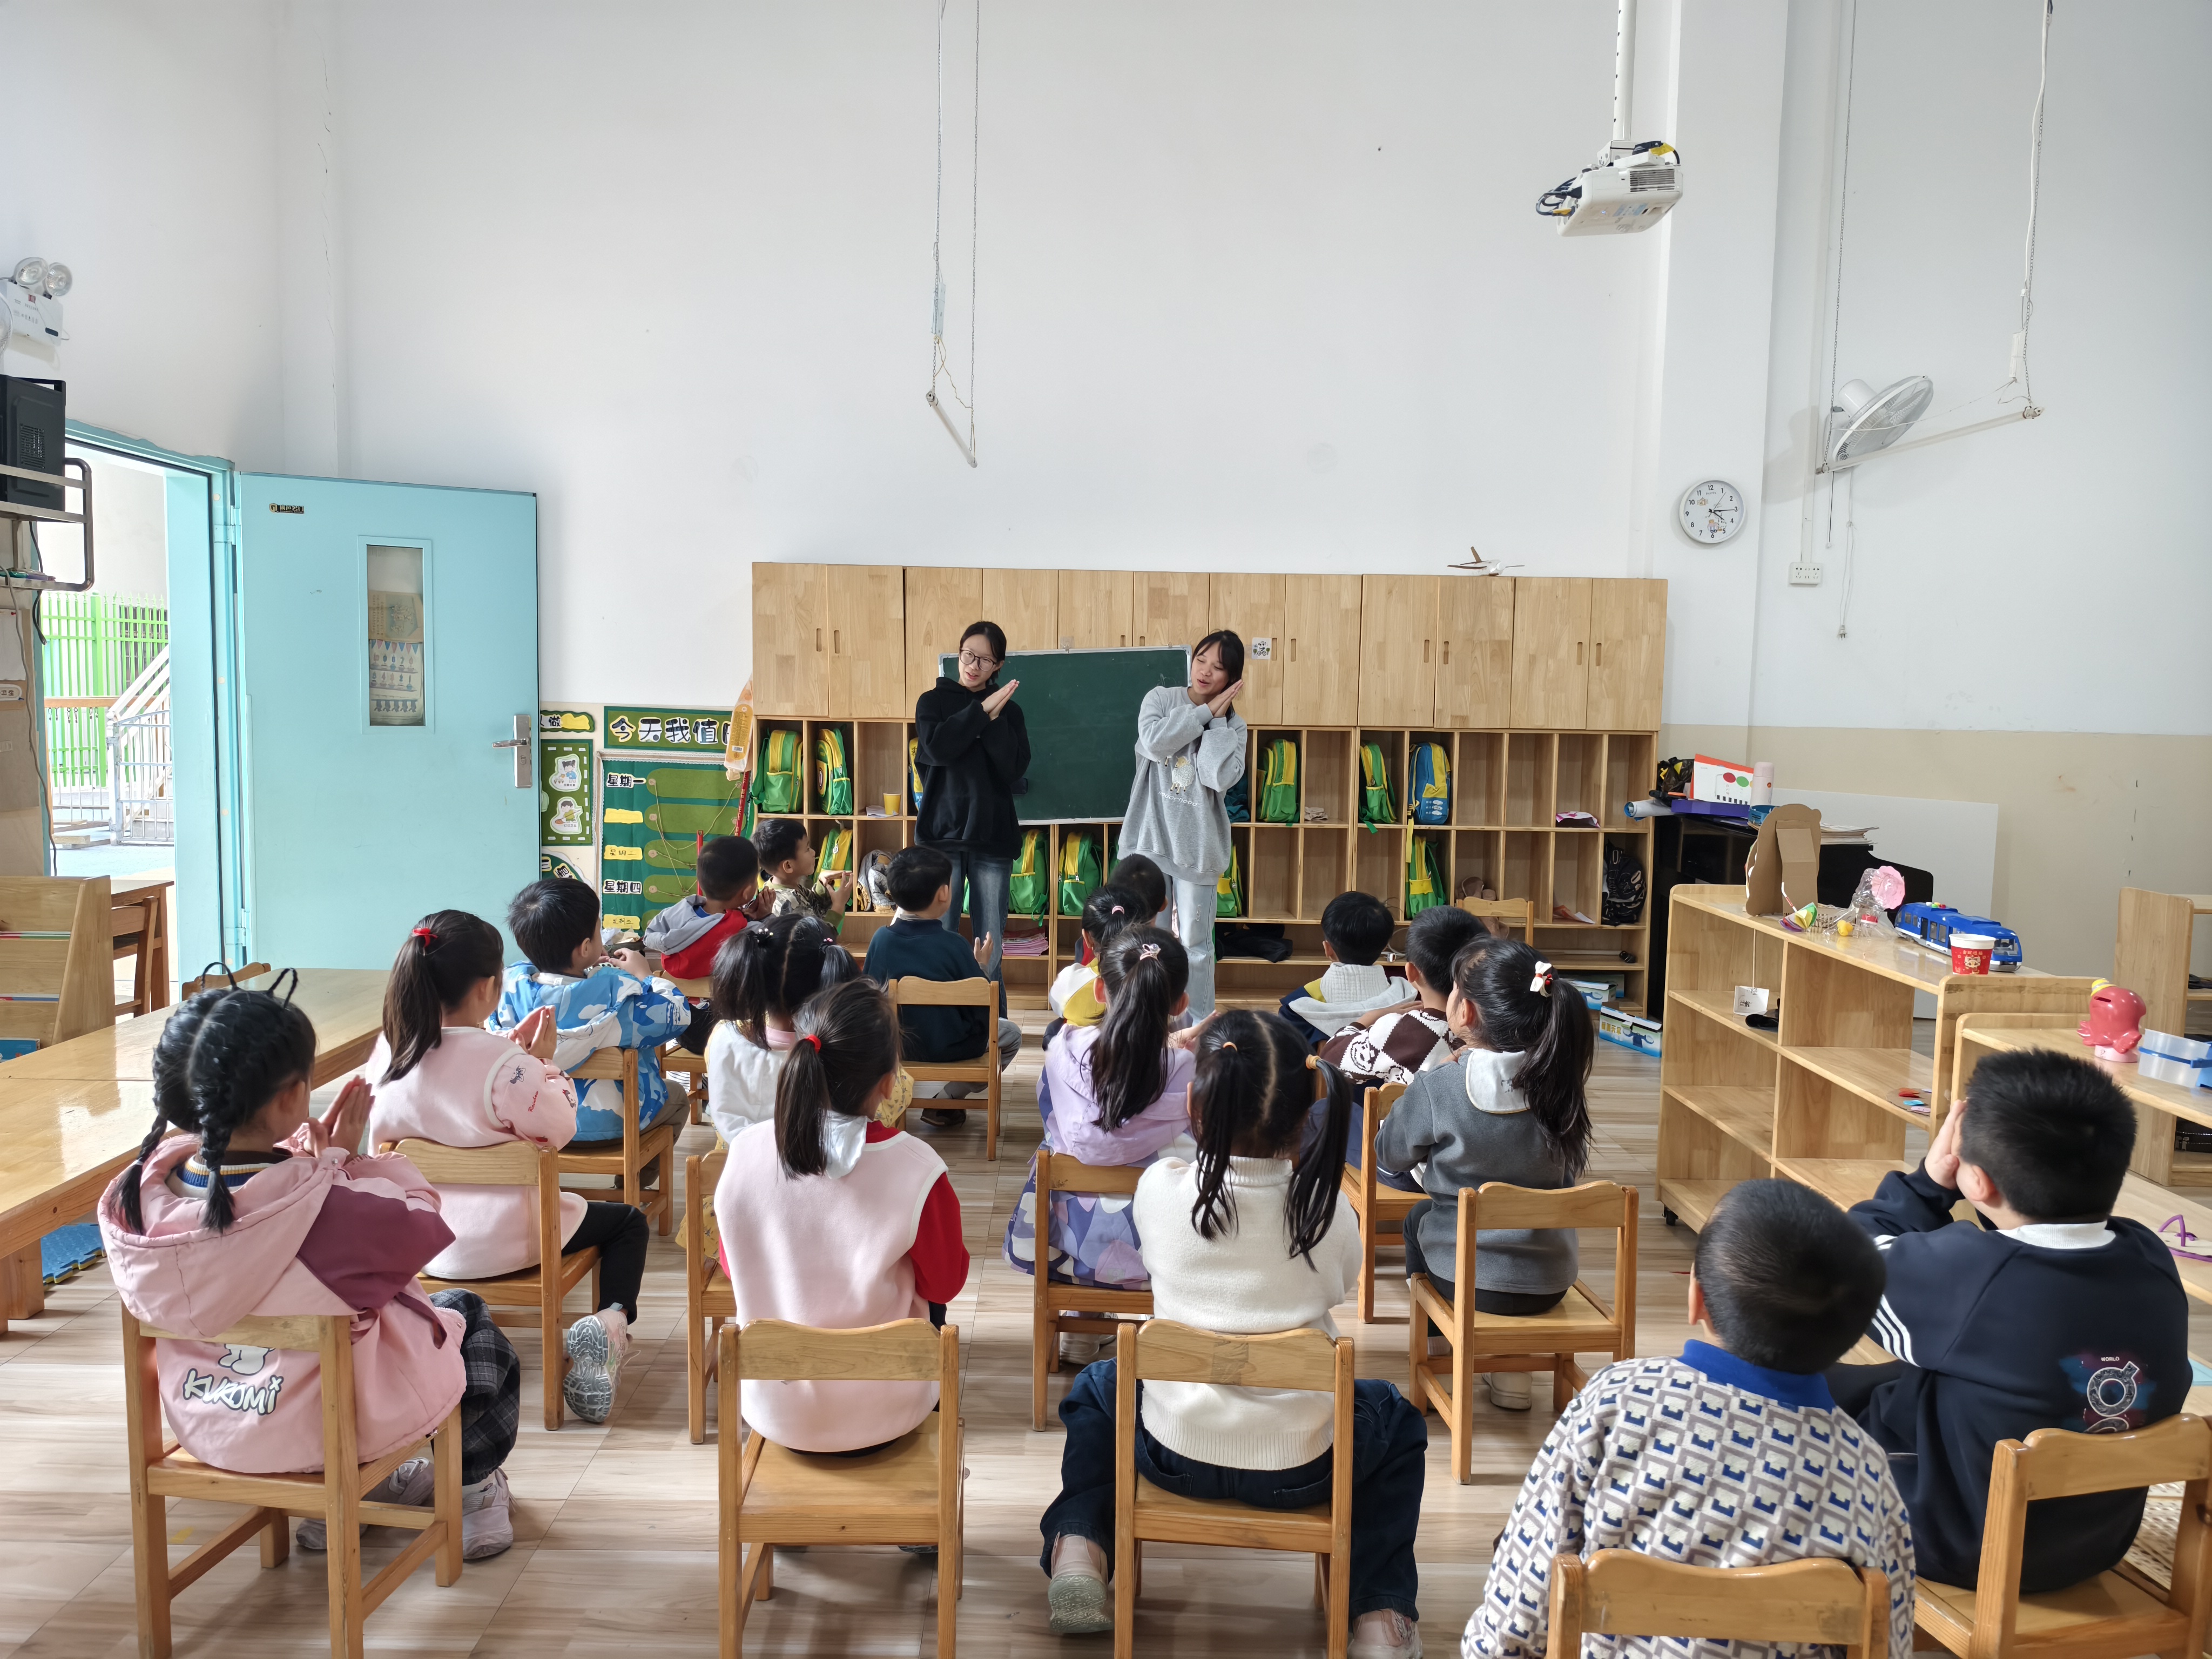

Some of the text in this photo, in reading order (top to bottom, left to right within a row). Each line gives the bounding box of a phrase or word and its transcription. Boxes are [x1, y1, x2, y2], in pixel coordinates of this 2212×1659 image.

[607, 774, 644, 787] 星期一
[604, 880, 642, 893] 星期四
